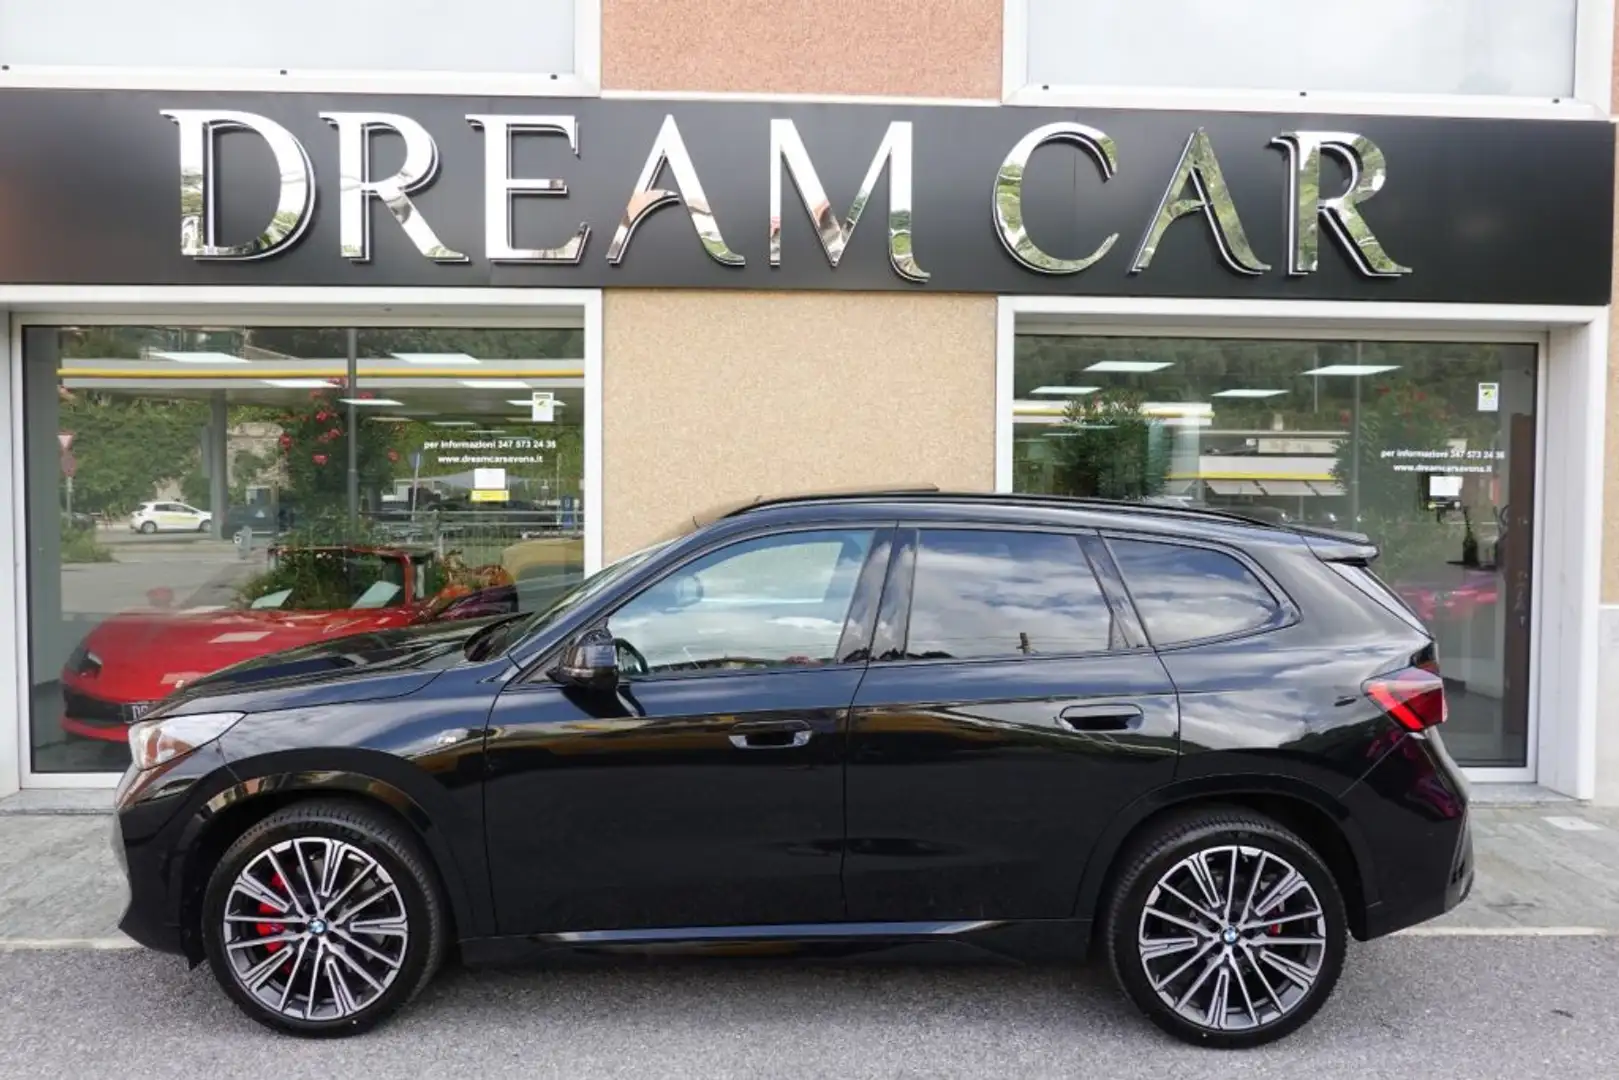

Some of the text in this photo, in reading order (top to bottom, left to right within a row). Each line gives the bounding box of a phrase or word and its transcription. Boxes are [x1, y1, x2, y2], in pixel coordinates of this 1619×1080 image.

[160, 109, 1412, 282] DREAM CAR
[424, 440, 439, 450] per
[441, 439, 496, 449] informazioni
[498, 440, 513, 449] 347
[1380, 450, 1395, 459] per
